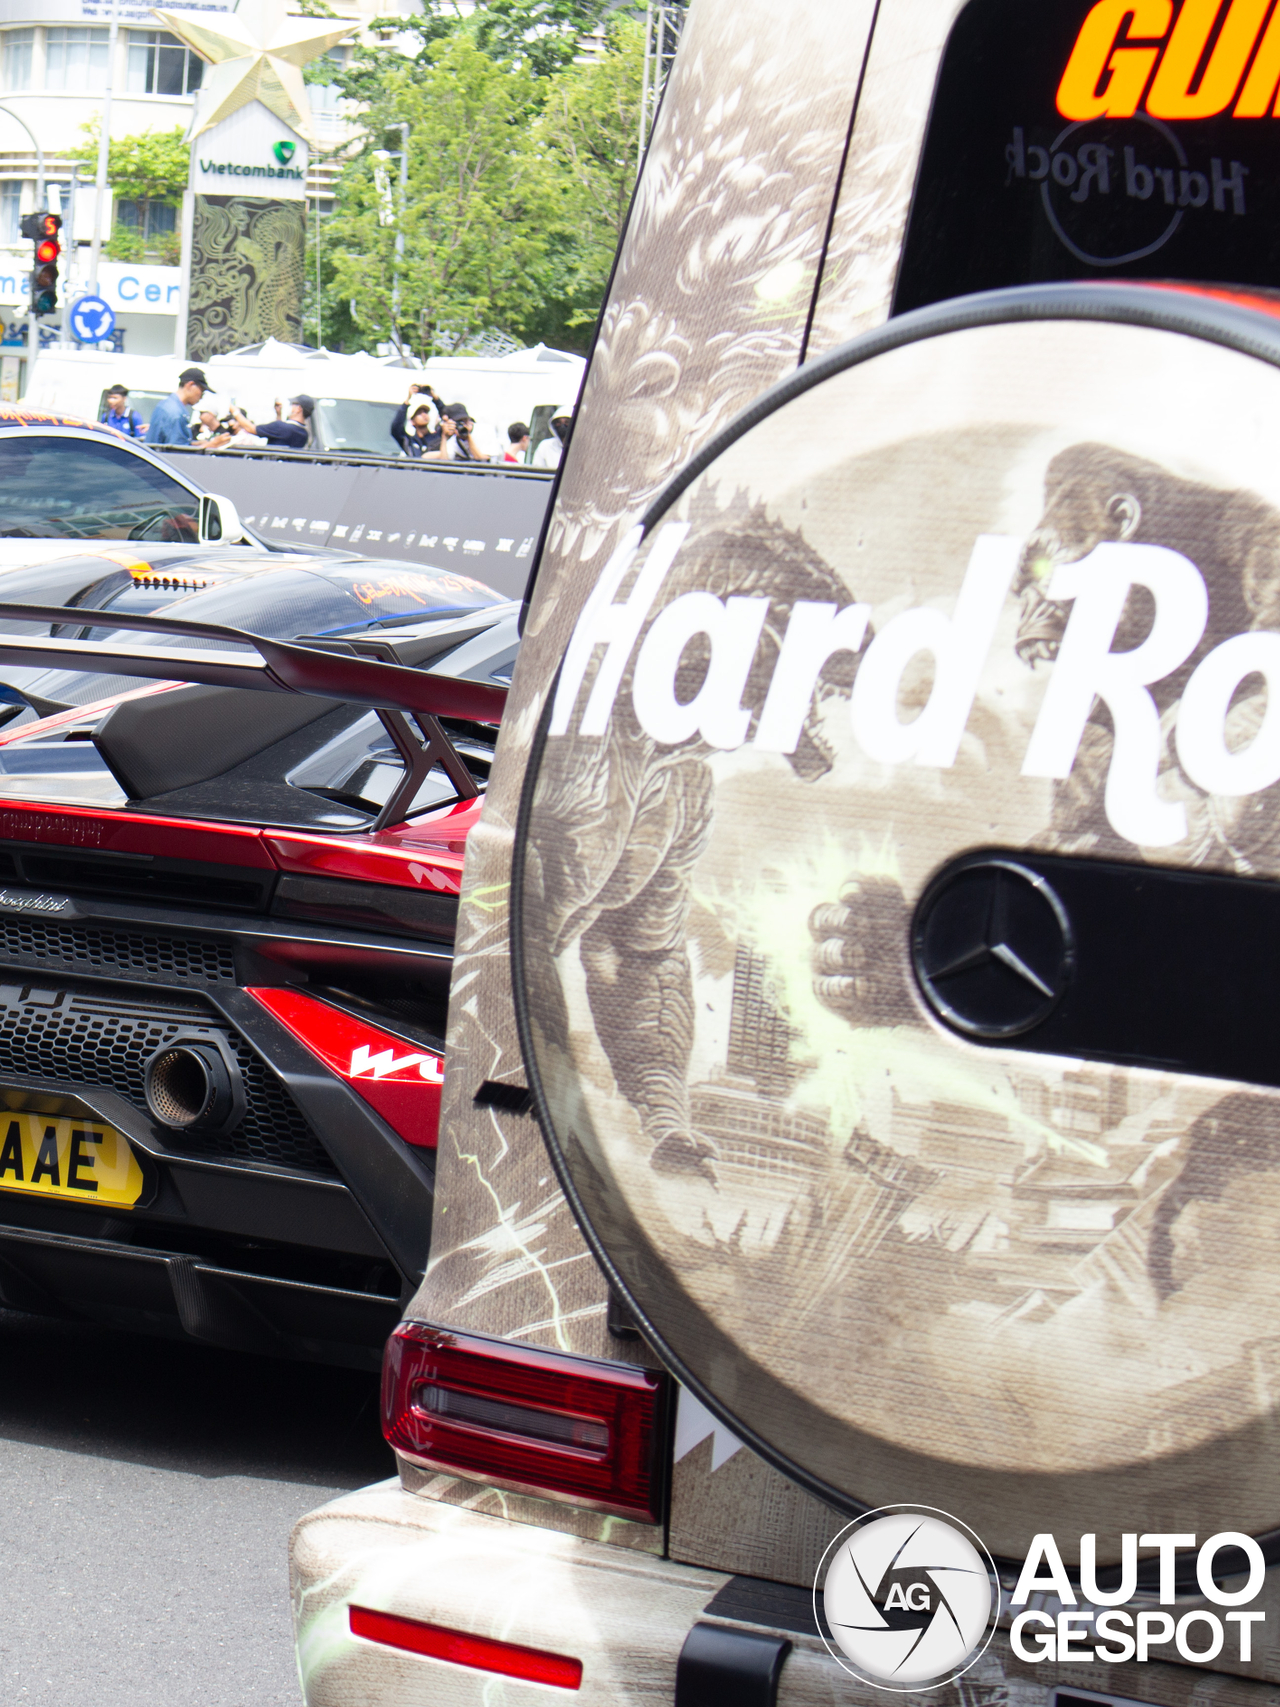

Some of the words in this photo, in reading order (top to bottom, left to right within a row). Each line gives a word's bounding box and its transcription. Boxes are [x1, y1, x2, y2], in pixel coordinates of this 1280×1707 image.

[199, 158, 305, 180] Vietcombank
[45, 217, 57, 236] 5
[547, 522, 1023, 768] Hard
